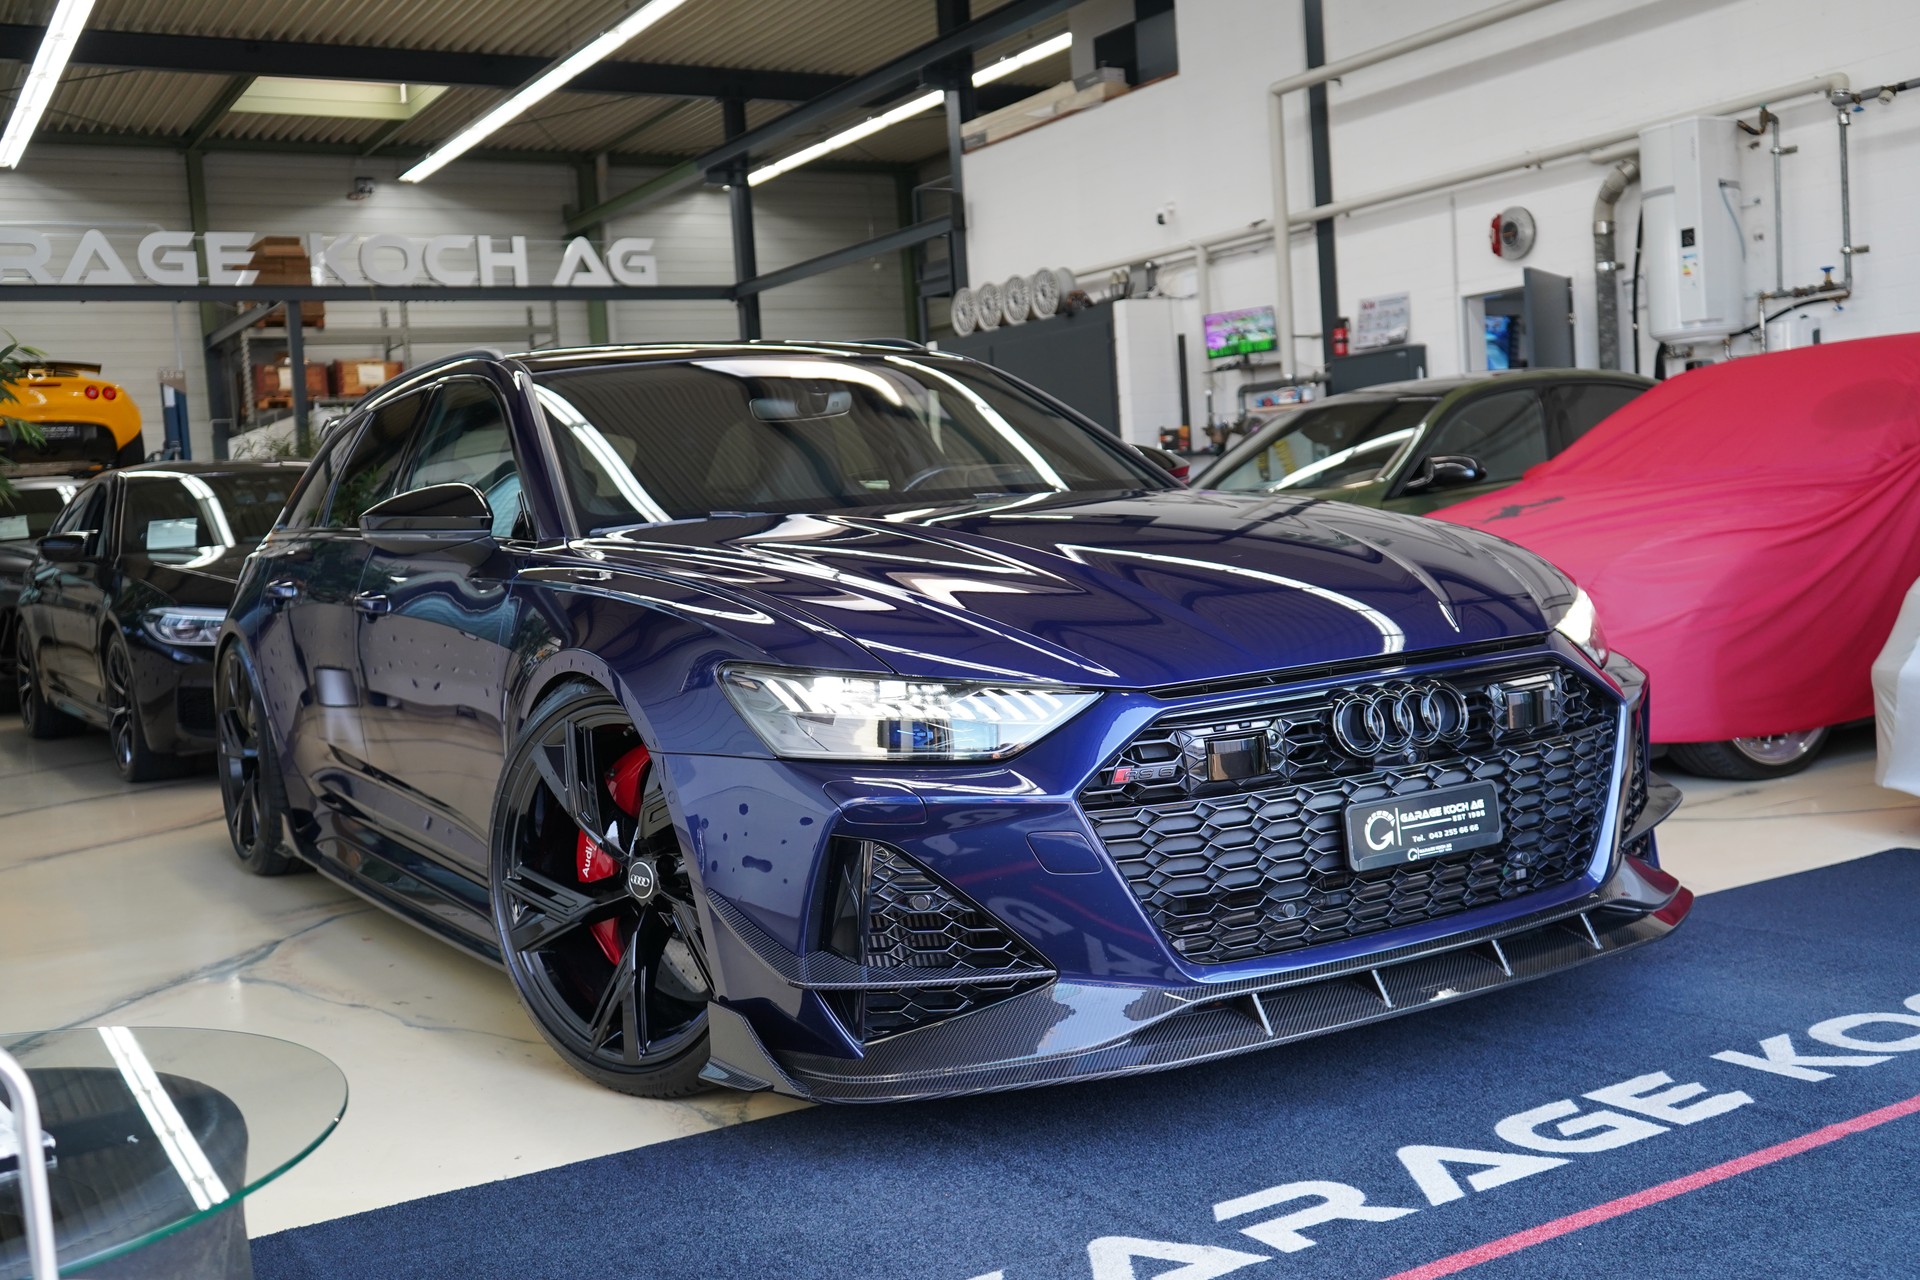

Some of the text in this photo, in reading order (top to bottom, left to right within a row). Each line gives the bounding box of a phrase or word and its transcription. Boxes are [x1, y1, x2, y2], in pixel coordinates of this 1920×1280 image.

[308, 232, 529, 286] KOCH
[552, 236, 658, 286] AG
[1400, 799, 1485, 823] GARAGE KOCH AG
[1412, 834, 1426, 843] Tel.
[1428, 831, 1443, 840] 043
[582, 846, 593, 878] Audi
[963, 993, 1920, 1280] ARAGE KO
